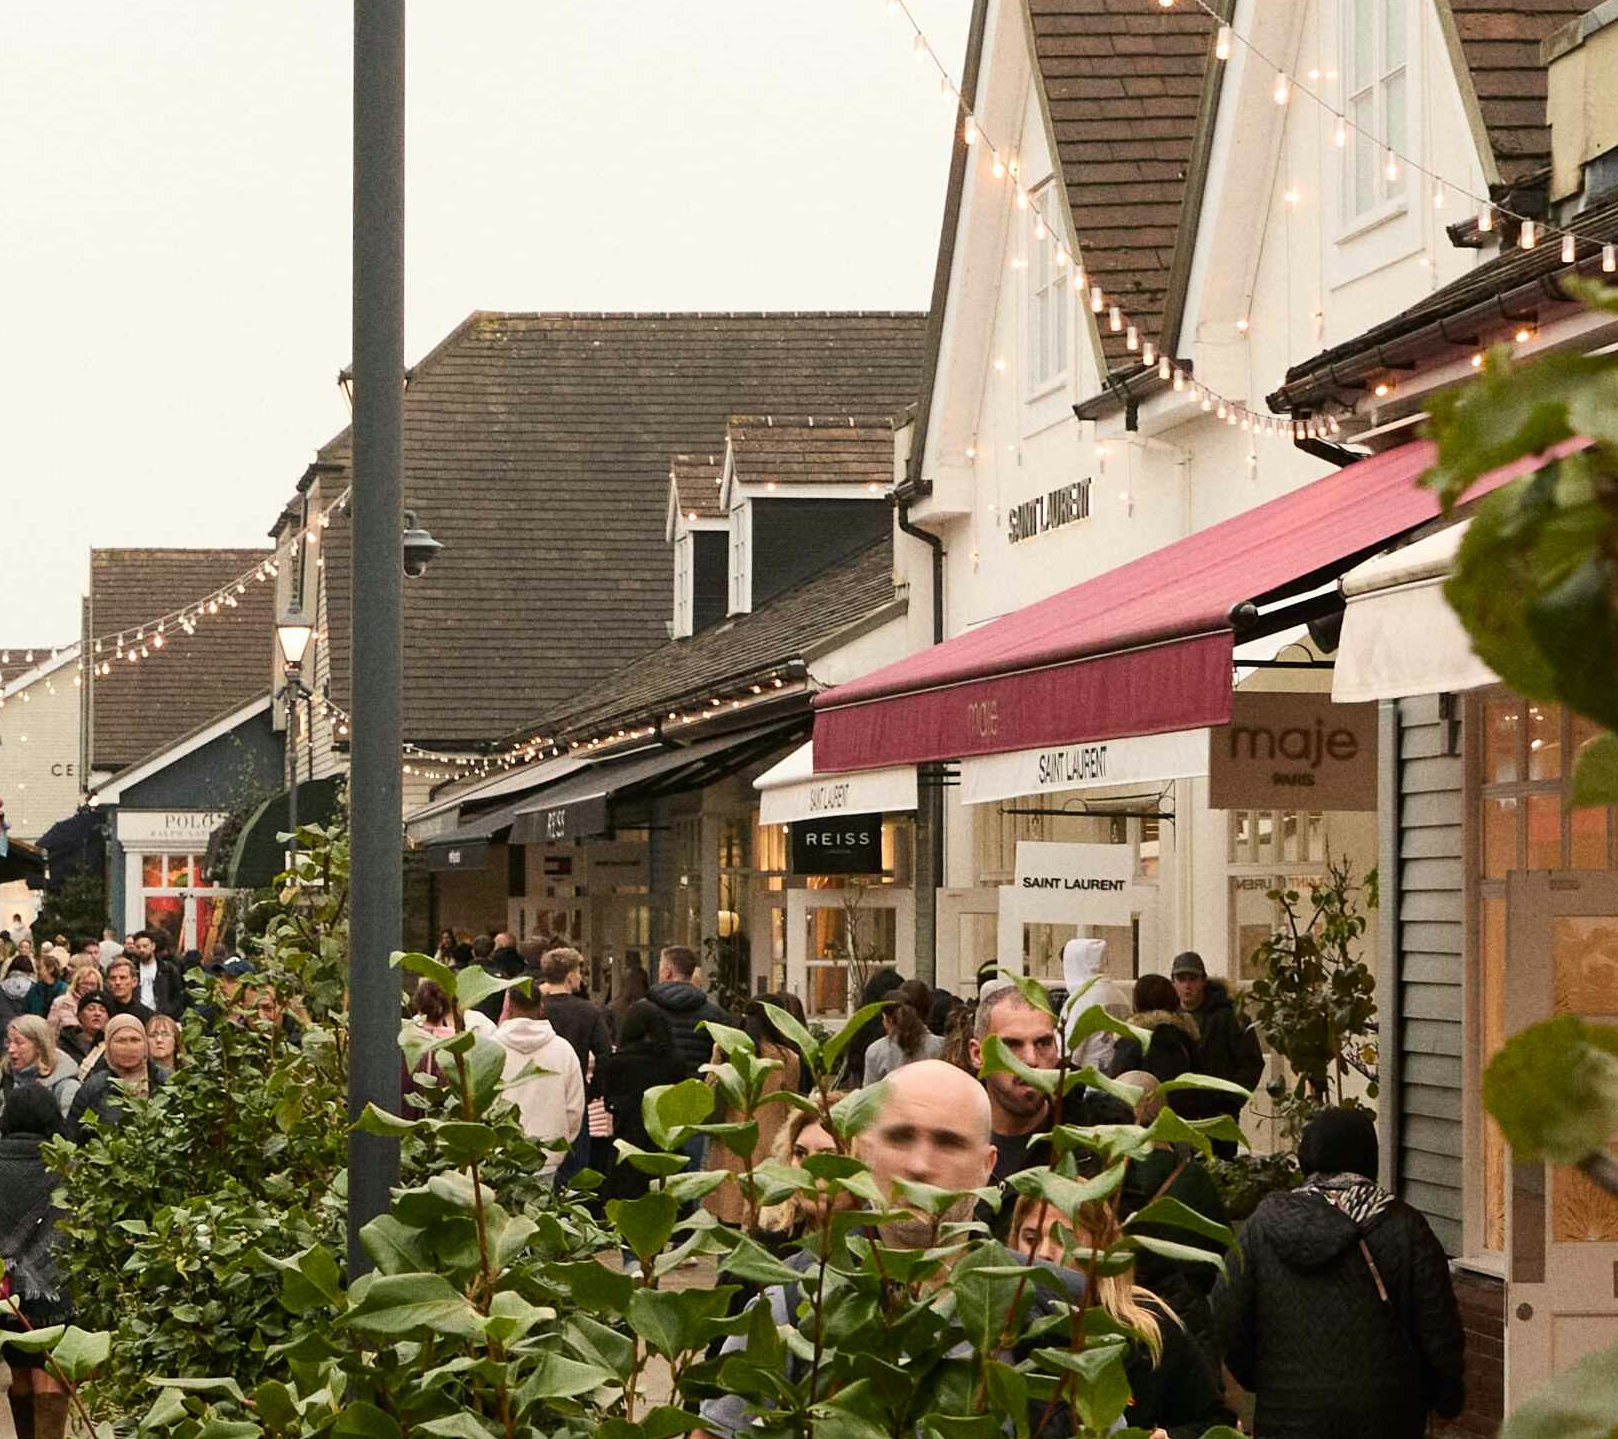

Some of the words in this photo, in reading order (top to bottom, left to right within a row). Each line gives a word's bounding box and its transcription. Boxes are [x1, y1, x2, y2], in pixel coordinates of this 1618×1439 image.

[1230, 717, 1359, 770] maje
[1038, 753, 1064, 784] SAINT
[1066, 745, 1107, 781] LAURENT
[1273, 772, 1316, 787] PARIS
[165, 814, 214, 829] POLO
[806, 833, 870, 846] REISS
[1023, 877, 1061, 889] SAINT
[1064, 879, 1126, 891] LAURENT
